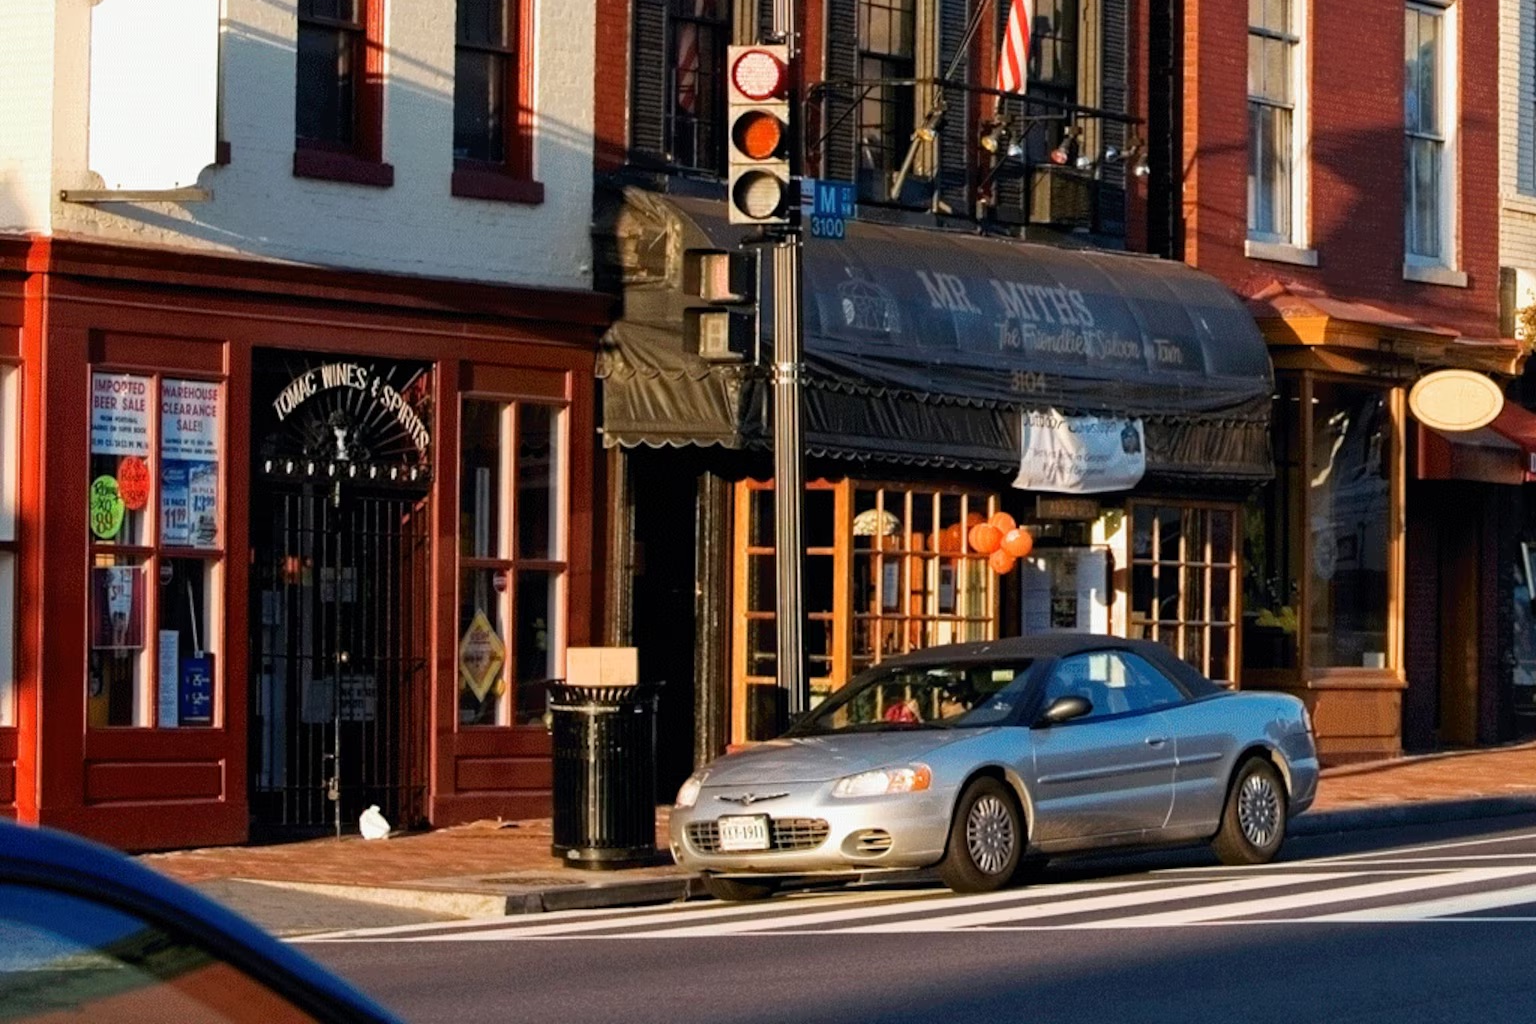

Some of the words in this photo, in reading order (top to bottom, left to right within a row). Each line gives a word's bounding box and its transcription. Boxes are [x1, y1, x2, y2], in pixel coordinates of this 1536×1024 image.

[821, 186, 836, 213] M
[812, 216, 844, 237] 3100
[915, 269, 982, 315] MR.
[995, 321, 1020, 351] The
[162, 385, 218, 401] WAREHOUSE
[1011, 370, 1046, 394] 3104
[94, 396, 117, 410] BEER
[122, 397, 145, 412] SALE
[162, 402, 217, 417] CLEARANCE
[321, 362, 367, 390] WINES
[380, 384, 430, 451] SPIRITS
